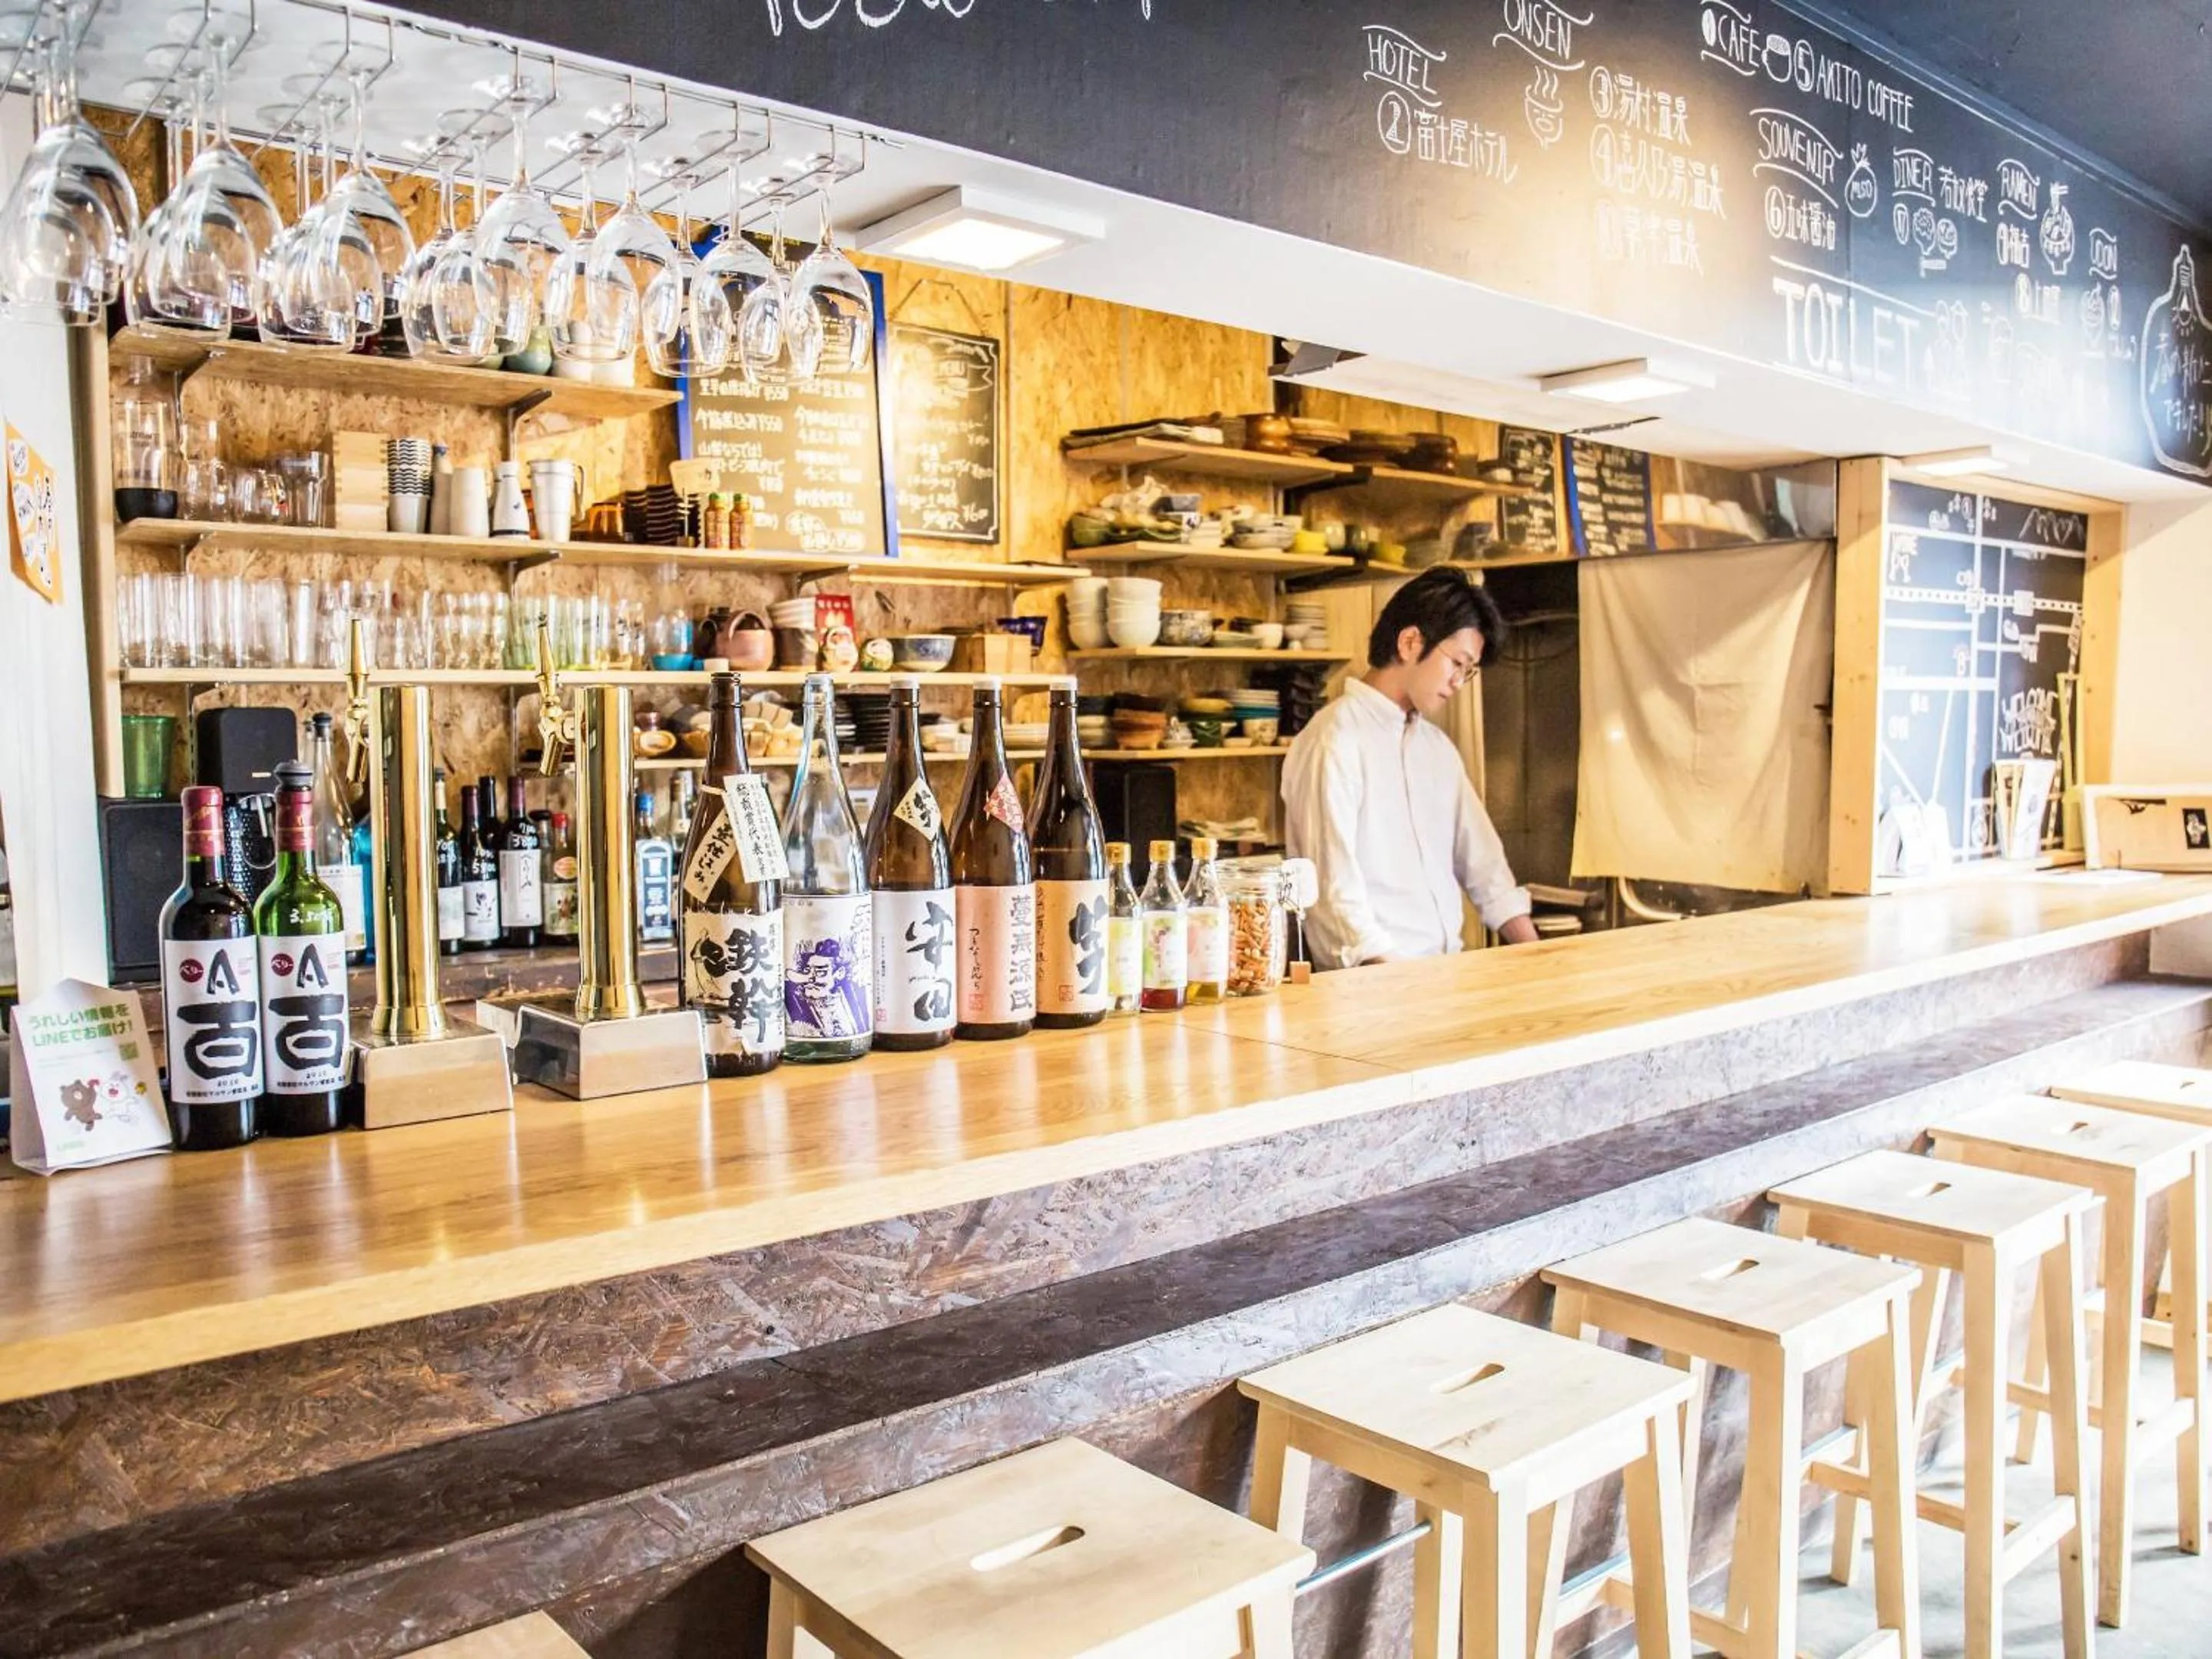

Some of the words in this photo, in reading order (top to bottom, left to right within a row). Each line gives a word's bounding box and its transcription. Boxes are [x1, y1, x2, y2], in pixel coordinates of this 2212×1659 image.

[1504, 0, 1571, 59] ONSEN
[1718, 15, 1762, 68] CAFE
[1369, 34, 1437, 94] HOTEL
[1816, 54, 1862, 109] AKITO
[1867, 79, 1915, 134] COFFEE
[1413, 108, 1518, 184] 富士屋ホテル
[1758, 118, 1835, 185] SOUVENIR
[1850, 180, 1873, 200] MISO
[1893, 157, 1932, 195] DINER
[2001, 167, 2037, 212] RAMEN
[1772, 276, 1921, 392] TOILET
[28, 1003, 130, 1029] うれしい情報を
